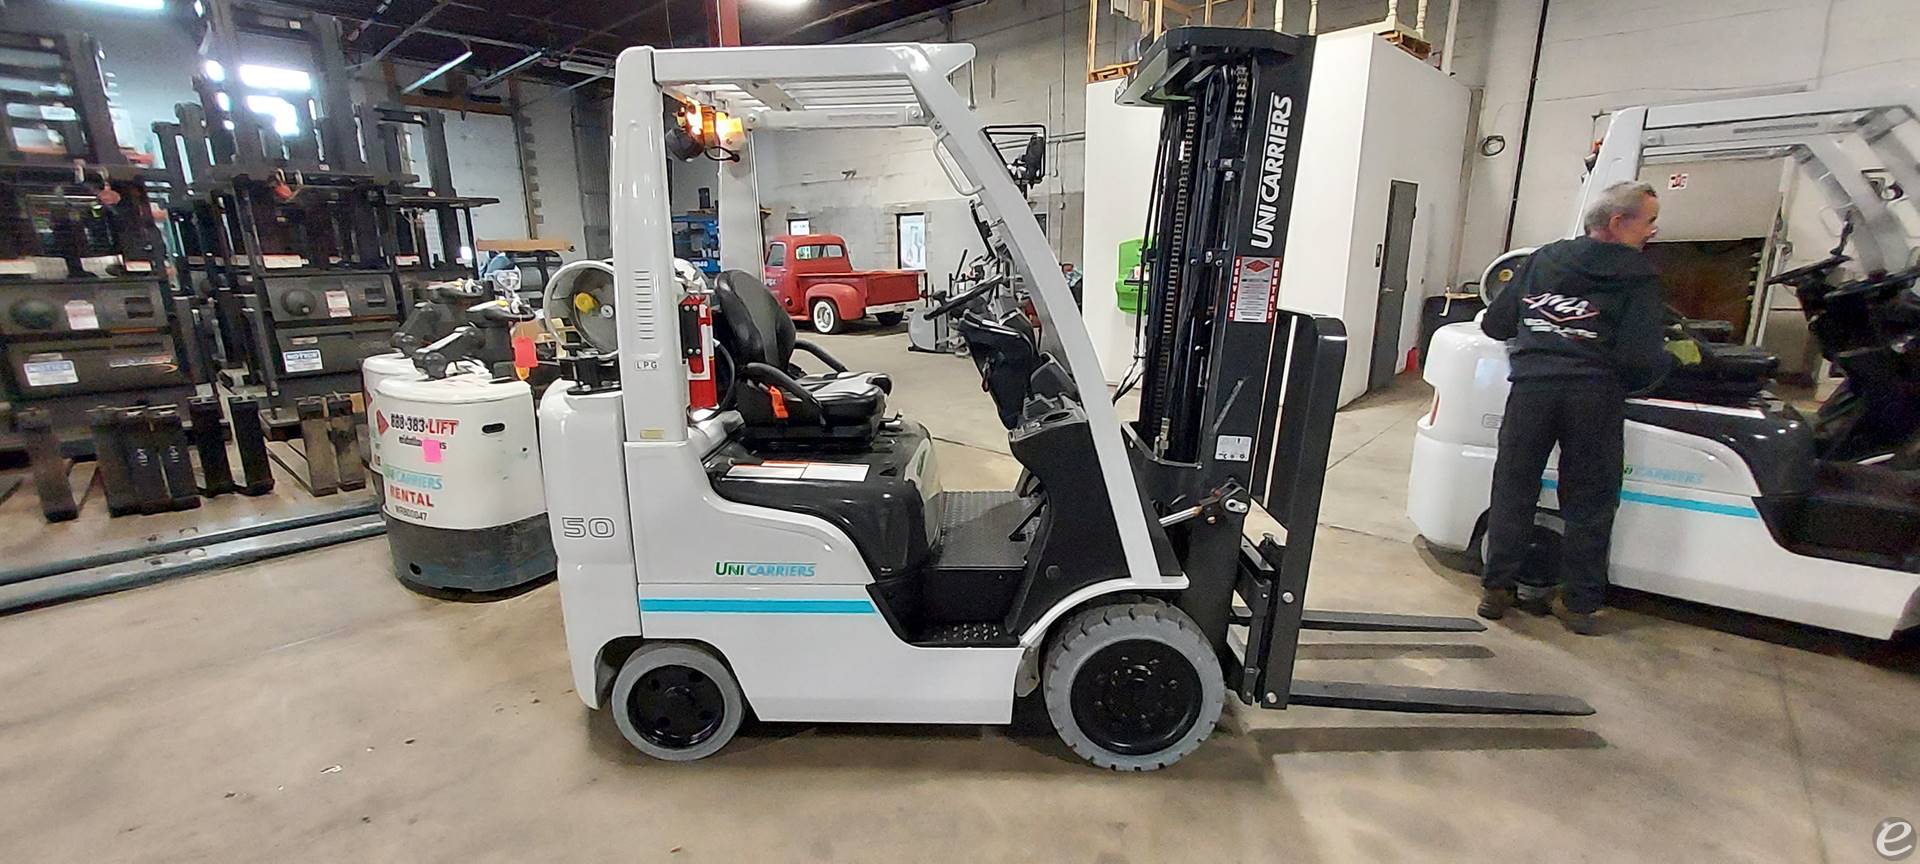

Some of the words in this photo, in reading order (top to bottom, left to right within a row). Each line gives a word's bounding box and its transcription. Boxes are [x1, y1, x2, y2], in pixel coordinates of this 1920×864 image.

[1228, 258, 1241, 319] SERVICE
[1267, 260, 1280, 320] RENTALS
[636, 360, 658, 370] LPG
[389, 484, 434, 508] RENTAL
[561, 517, 615, 539] 50
